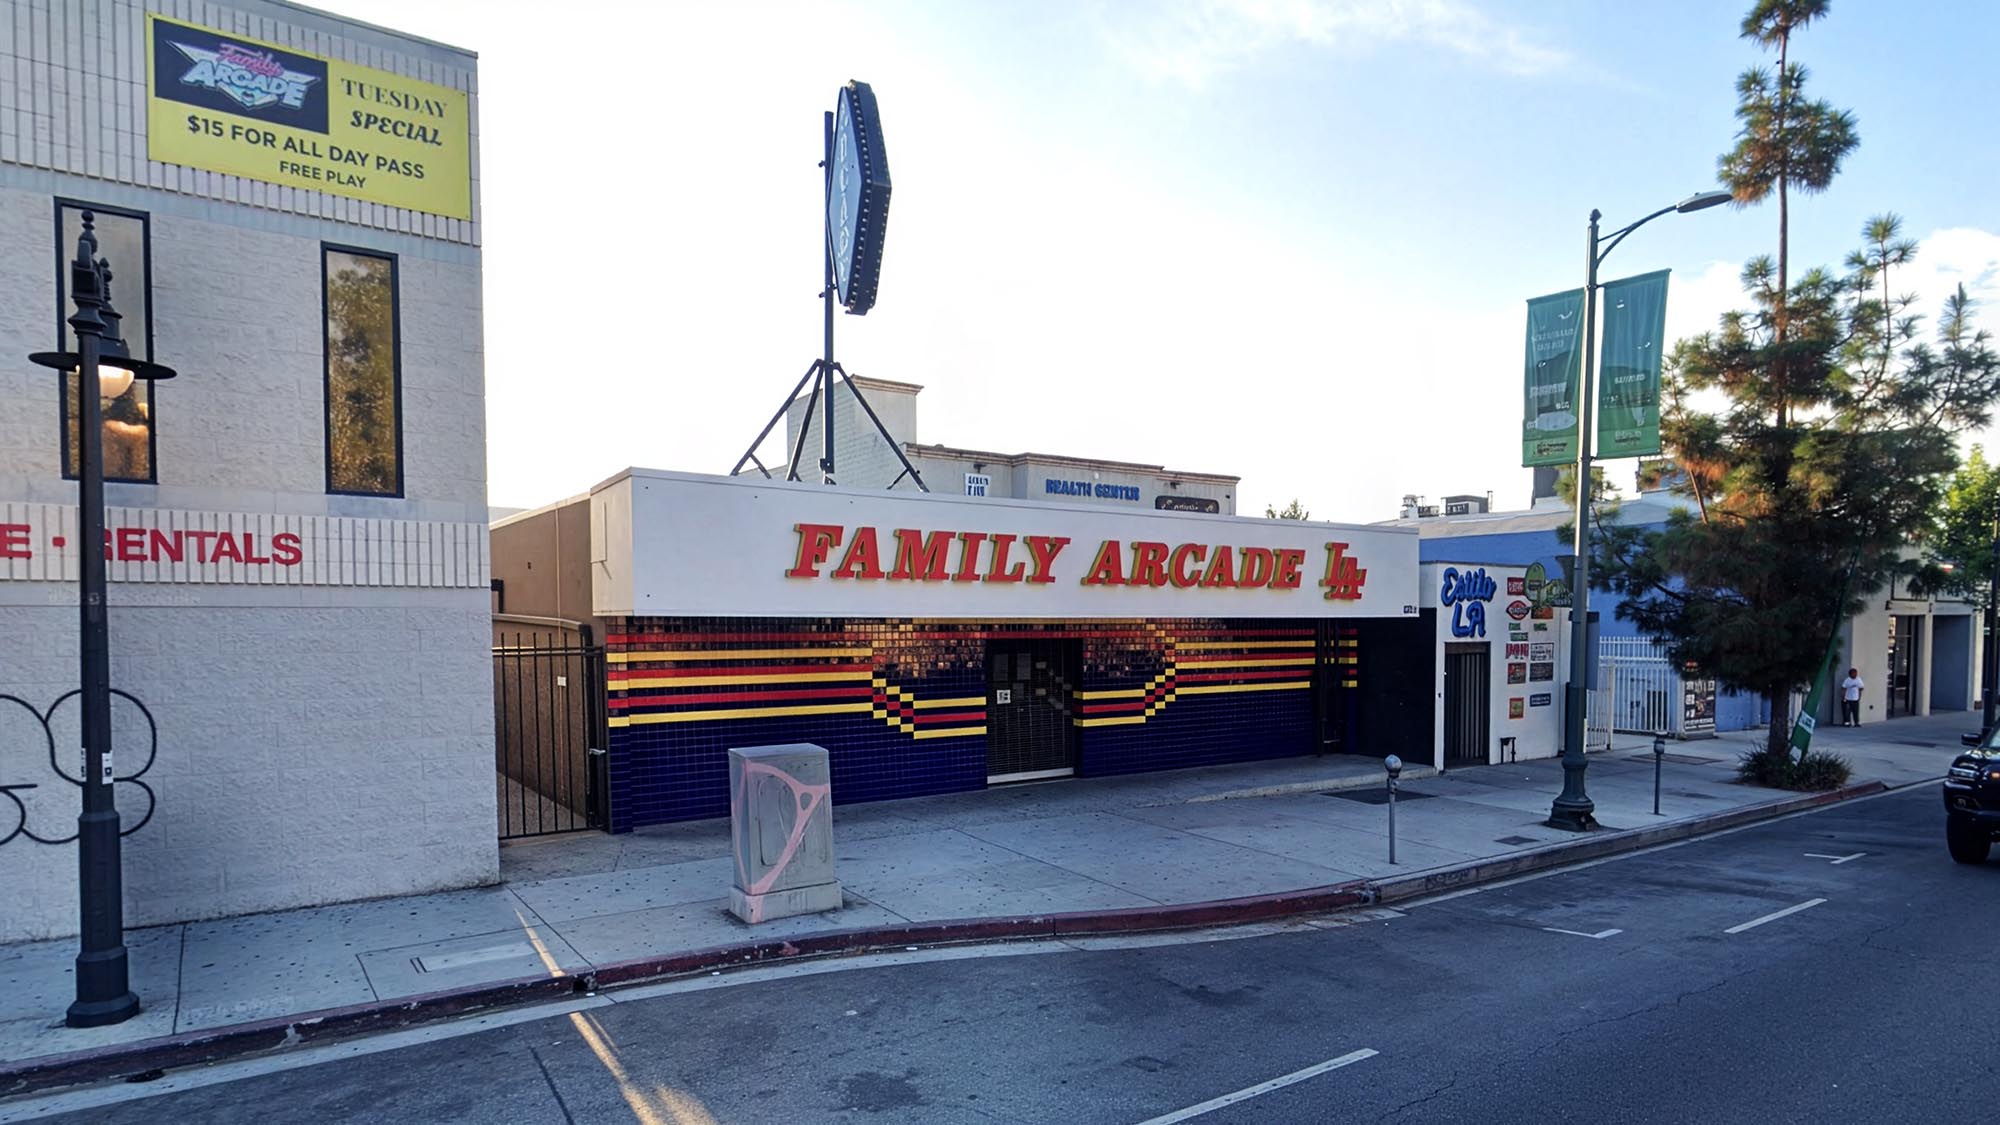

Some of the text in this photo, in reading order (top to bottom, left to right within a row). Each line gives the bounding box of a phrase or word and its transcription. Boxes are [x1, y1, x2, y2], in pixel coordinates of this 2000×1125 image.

[180, 59, 308, 109] ARCADE
[341, 78, 448, 118] TUESDAY
[187, 114, 425, 179] $15 FOR ALL DAY PASS
[351, 110, 443, 146] SPECIAL
[280, 160, 366, 188] FREE PLAY
[104, 528, 303, 565] ENTALS
[785, 523, 1367, 600] FAMILY ARCADE LA
[1452, 601, 1486, 638] LA
